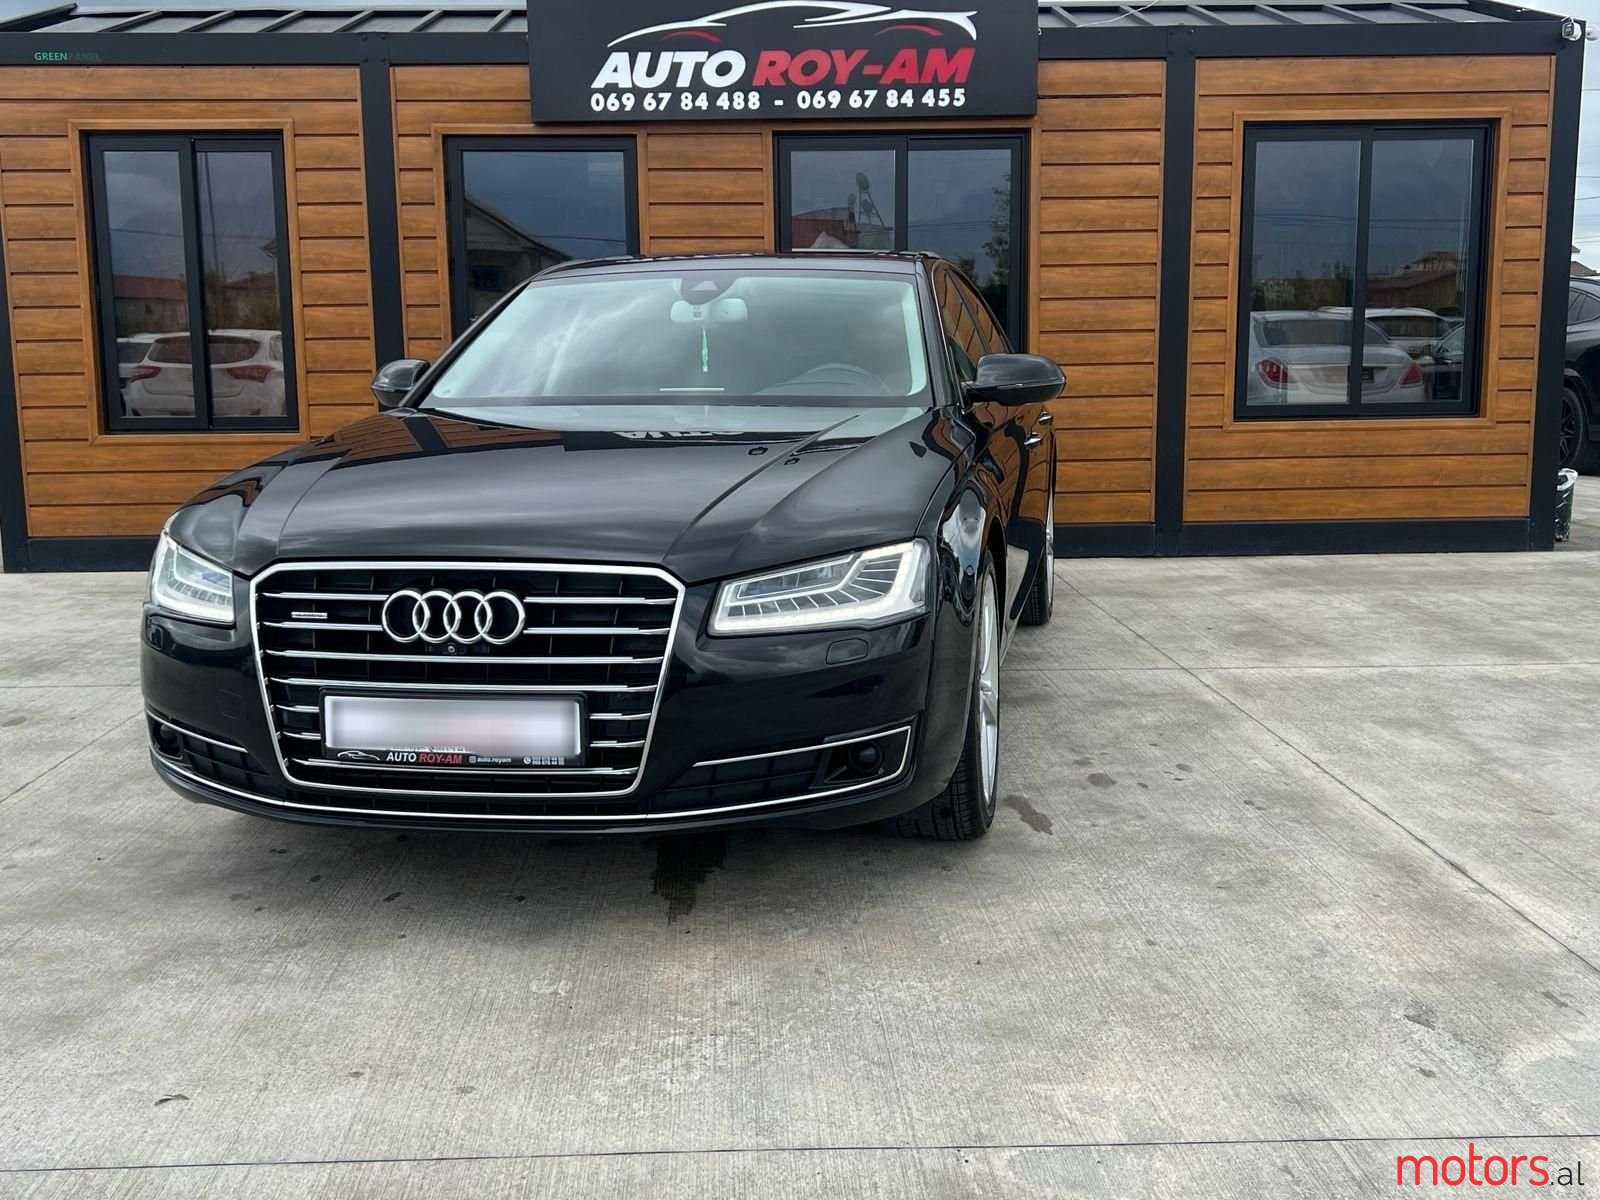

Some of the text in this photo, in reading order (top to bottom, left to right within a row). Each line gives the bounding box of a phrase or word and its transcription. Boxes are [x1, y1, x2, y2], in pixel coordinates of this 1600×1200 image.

[590, 47, 976, 88] AUTO ROY-AM
[590, 92, 635, 111] 069
[643, 92, 672, 111] 67
[680, 91, 708, 110] 84
[716, 91, 760, 110] 488
[797, 90, 841, 109] 069
[849, 89, 878, 108] 67
[886, 89, 915, 108] 84
[921, 88, 965, 107] 455
[386, 752, 463, 765] AUTO ROY-AM
